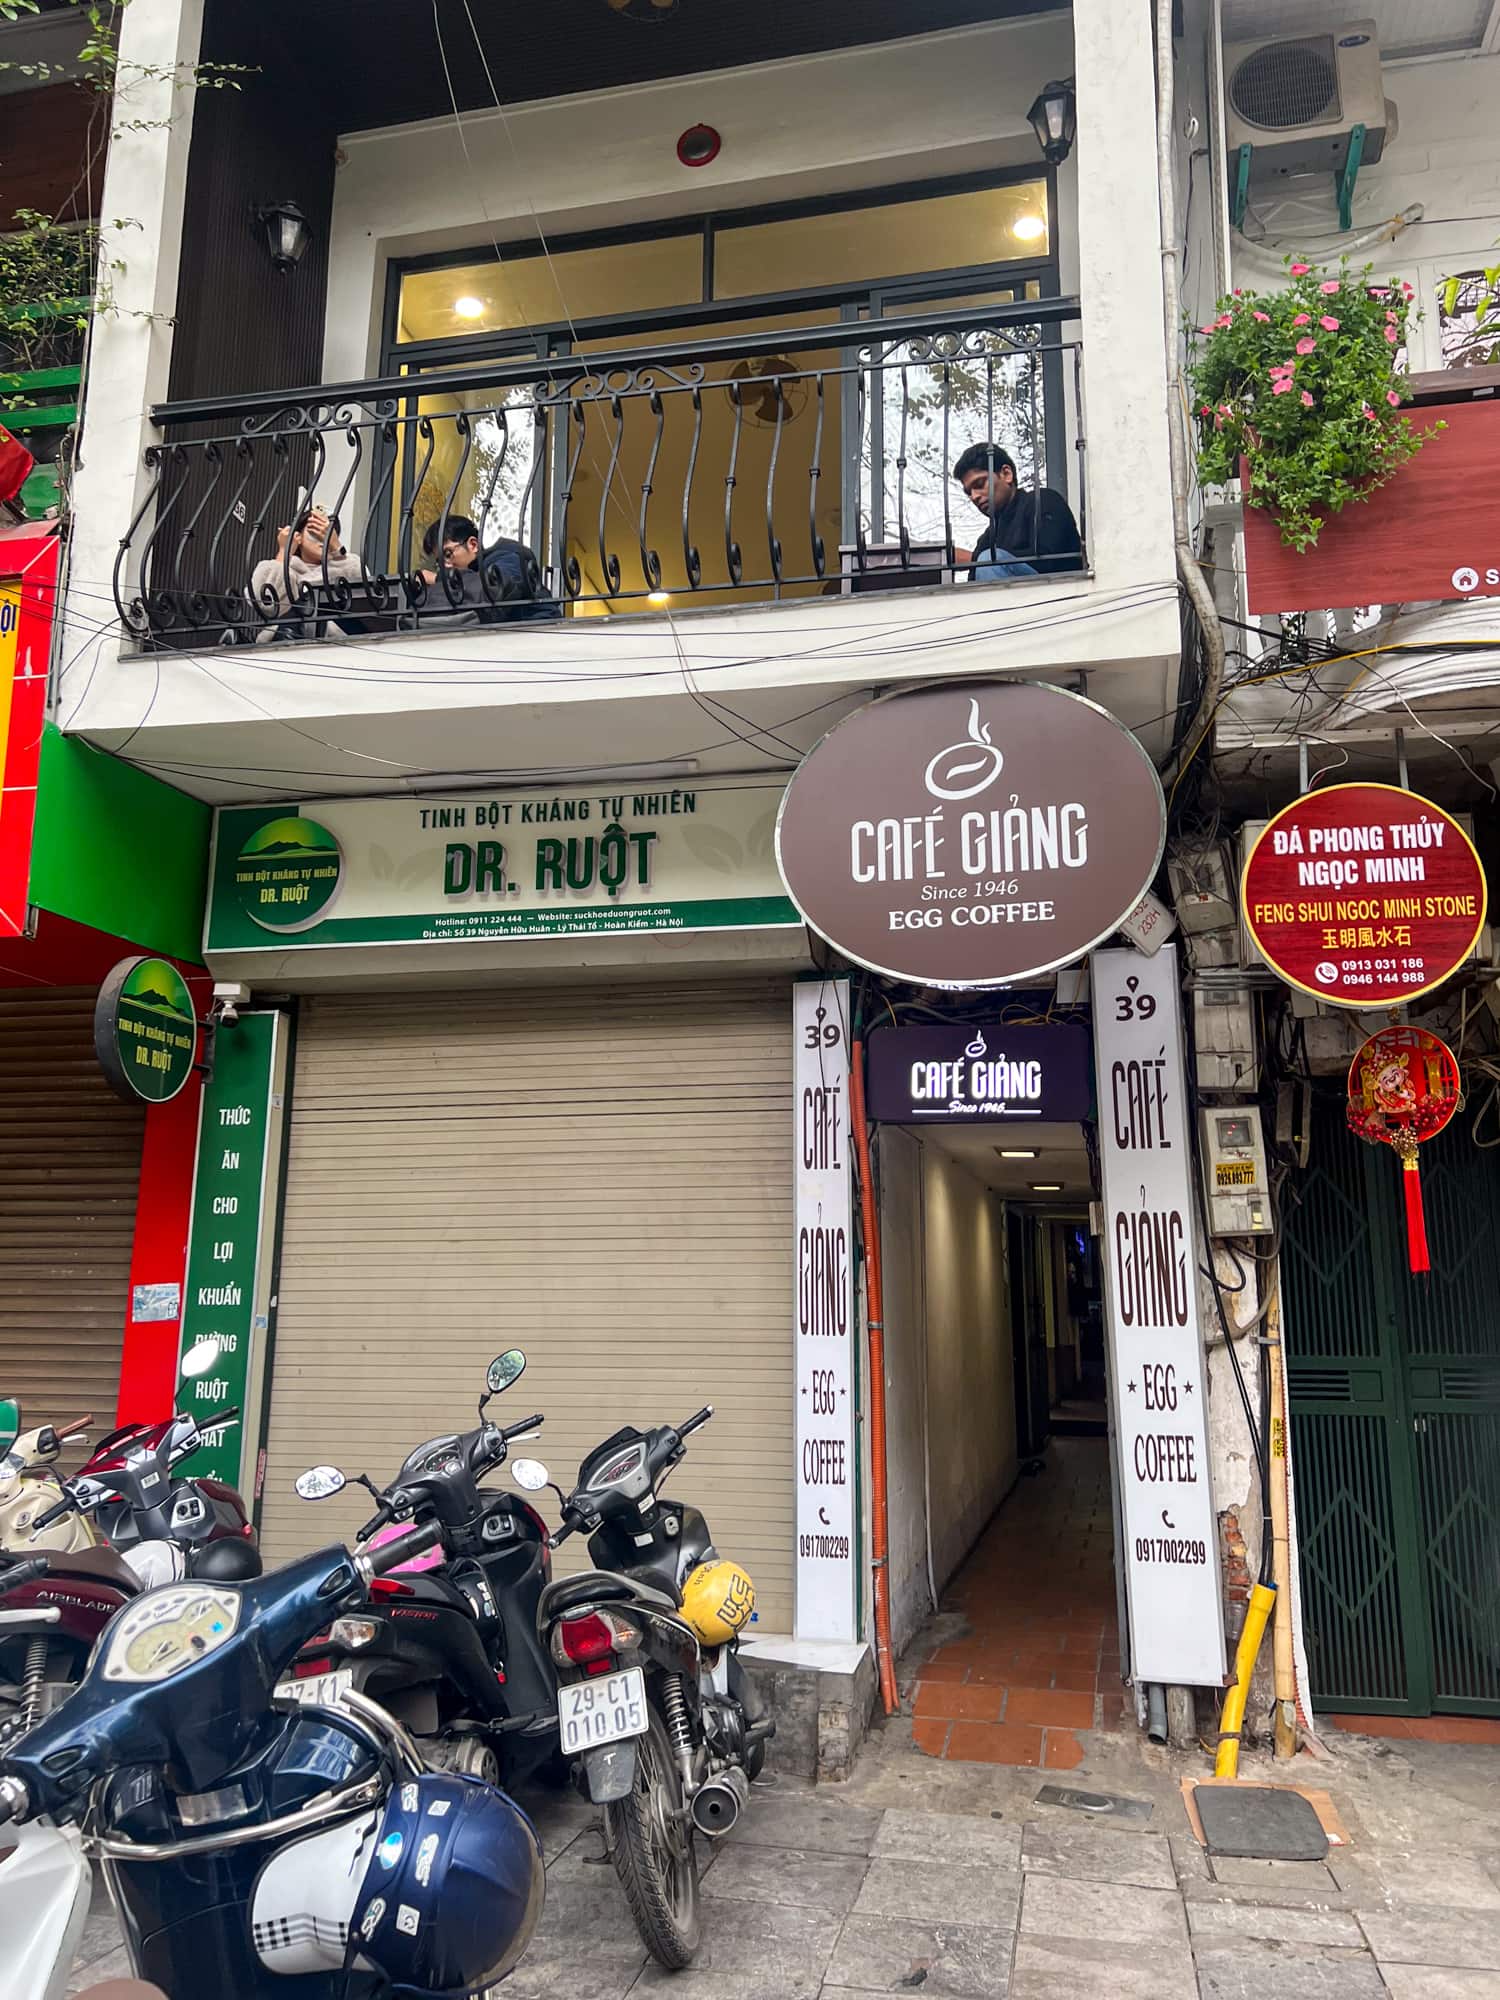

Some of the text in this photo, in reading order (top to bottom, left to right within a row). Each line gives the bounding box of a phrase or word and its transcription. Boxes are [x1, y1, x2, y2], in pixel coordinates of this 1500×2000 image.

[419, 790, 696, 829] TINH BỘT KHÁNG TỰ NHIÊN
[851, 794, 1089, 883] CAFÉ GIẢNG
[1273, 815, 1445, 855] ĐÁ PHONG THỦY
[444, 823, 656, 896] DR. RUỘT
[1298, 856, 1425, 890] NGỌC MINH
[260, 883, 310, 904] DR. RUỘT
[920, 878, 1019, 901] Since 1946
[435, 918, 467, 927] Hotline:
[469, 917, 488, 925] 0911
[490, 916, 505, 924] 224
[538, 913, 572, 921] Website:
[574, 908, 671, 919] suckhoeduongruot.com
[888, 901, 1056, 931] EGG COFFEE
[1255, 896, 1477, 923] FENG SHUI NGOC MINH STONE
[466, 928, 476, 936] 39
[1322, 926, 1412, 950] 玉明風水石
[1342, 958, 1424, 970] 0913 031 186
[1343, 972, 1425, 985] 0946 144 988
[1115, 994, 1157, 1022] 39
[804, 1025, 841, 1050] 39
[136, 1046, 150, 1066] DR.
[911, 1053, 1042, 1099] CAFÉ GIẢNG
[948, 1100, 978, 1114] Since
[1112, 1045, 1171, 1150] CAFÉ
[219, 1105, 251, 1126] THỨC
[803, 1074, 841, 1170] CAFÉ
[221, 1149, 240, 1169] ĂN
[213, 1197, 238, 1215] CHO
[213, 1242, 233, 1263] LỢI
[1116, 1184, 1189, 1327] GIẢNG
[800, 1202, 847, 1337] GIẢNG
[198, 1281, 242, 1306] KHUẨN
[195, 1377, 229, 1403] RUỘT
[812, 1370, 836, 1415] EGG
[1143, 1364, 1178, 1411] EGG
[803, 1439, 846, 1485] COFFEE
[1134, 1434, 1197, 1482] COFFEE
[800, 1534, 849, 1559] 0917002299
[1135, 1538, 1206, 1565] 0917002299
[571, 1675, 632, 1717] 29-C1
[566, 1702, 642, 1747] 010.05
